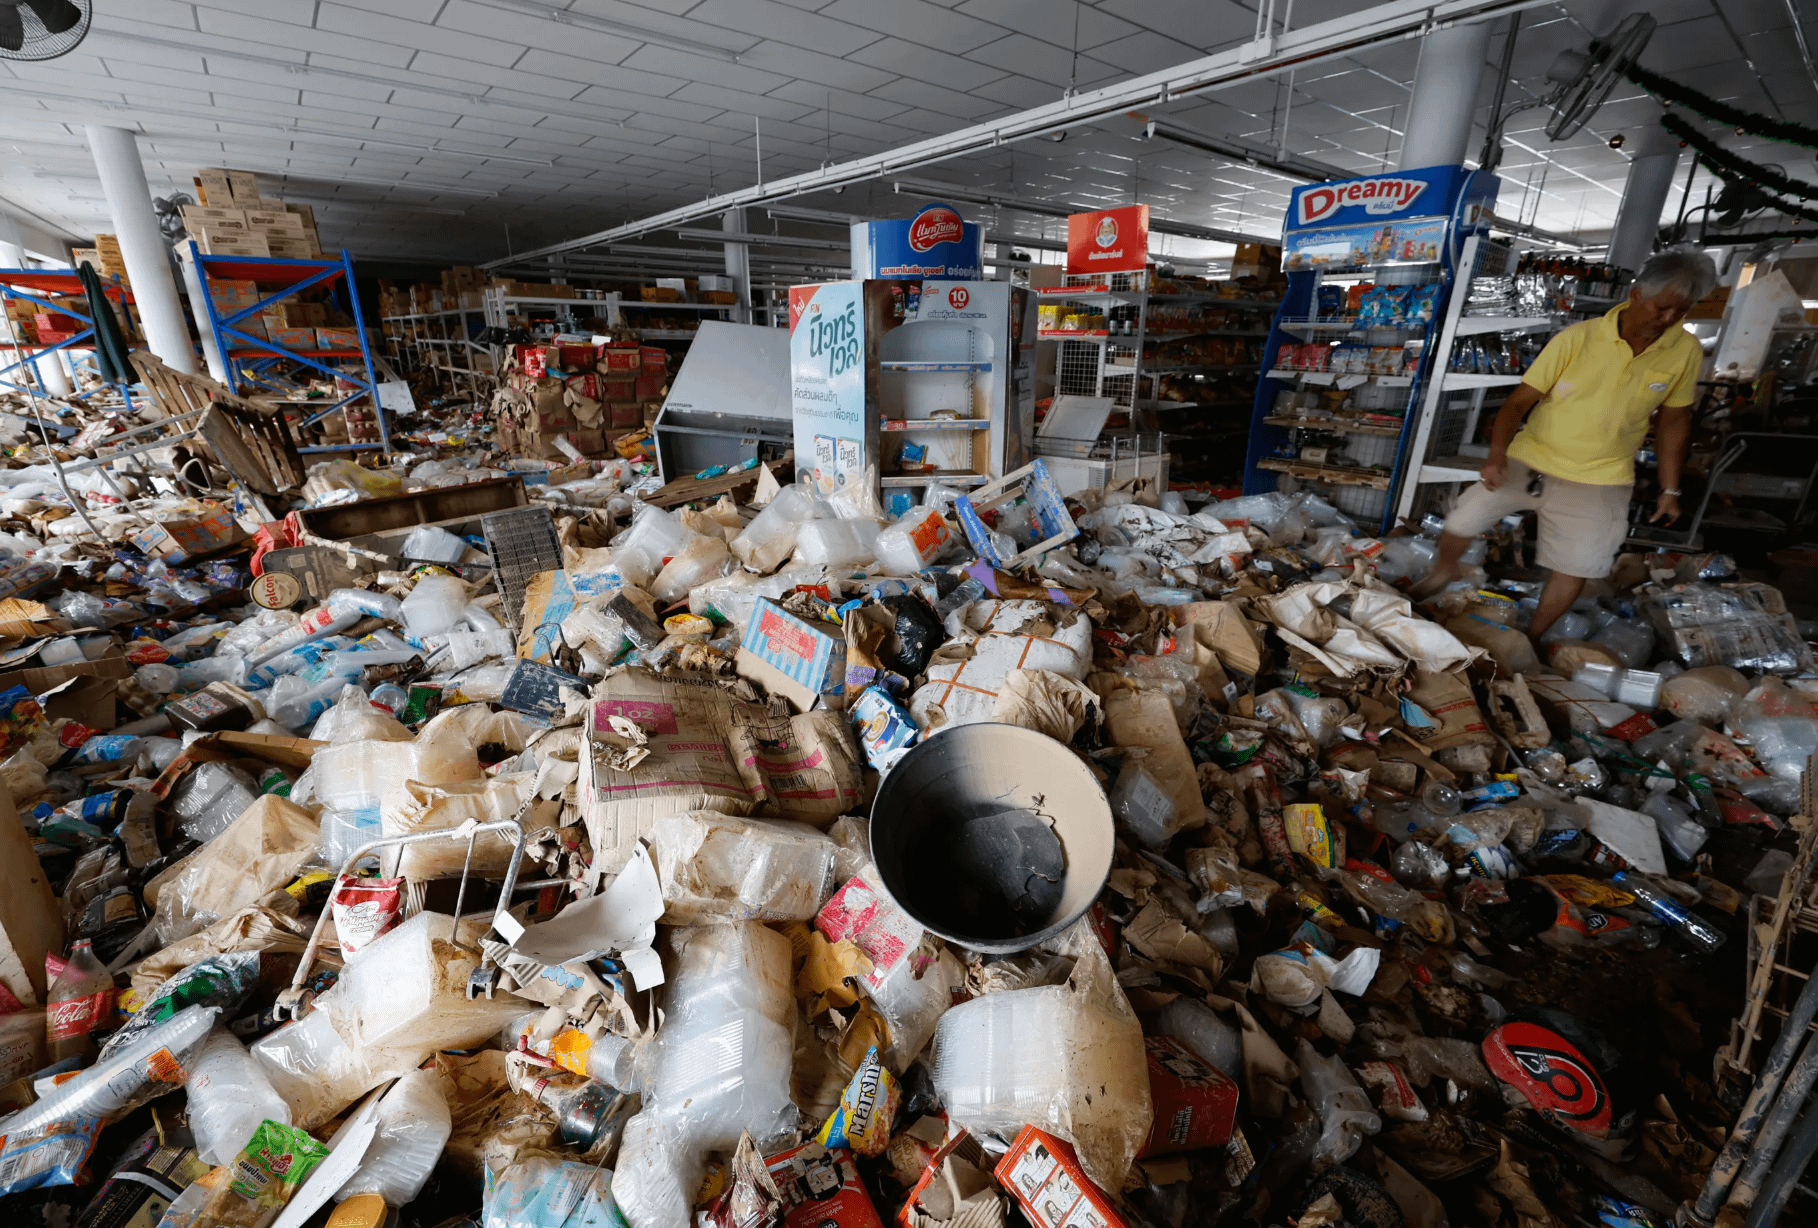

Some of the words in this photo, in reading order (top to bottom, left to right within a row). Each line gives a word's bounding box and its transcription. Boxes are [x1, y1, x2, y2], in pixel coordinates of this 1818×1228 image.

[1303, 181, 1422, 221] Dreamy
[951, 291, 966, 301] 10
[265, 575, 282, 607] Falcon
